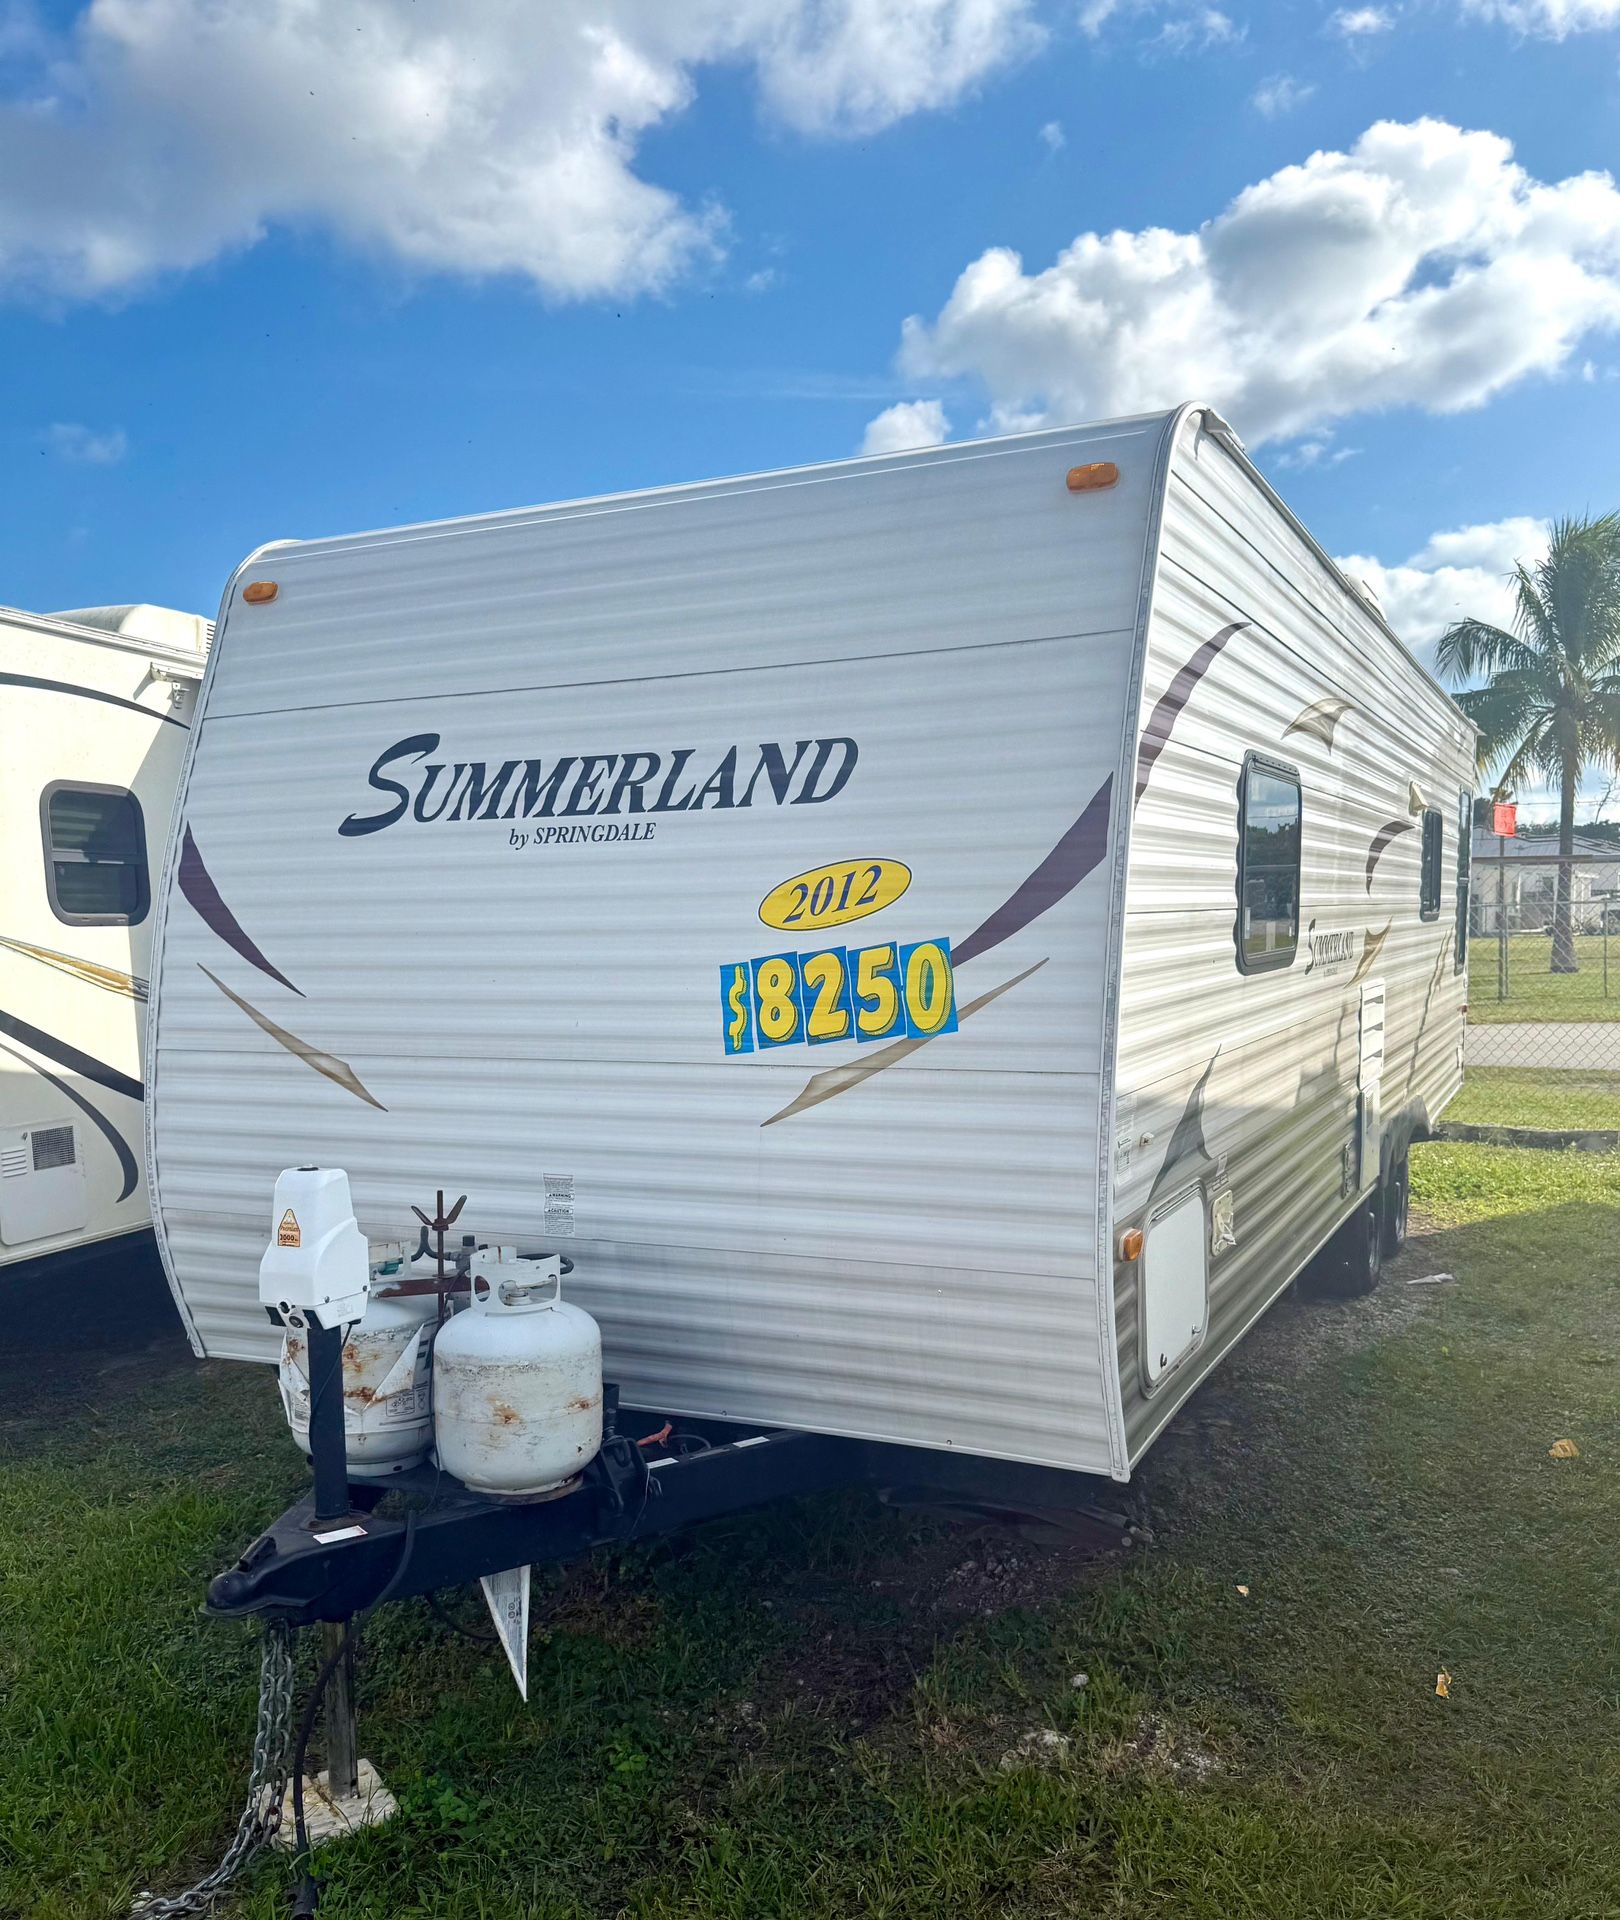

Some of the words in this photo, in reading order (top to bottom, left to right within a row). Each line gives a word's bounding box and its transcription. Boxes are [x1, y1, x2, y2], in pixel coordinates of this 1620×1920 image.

[337, 732, 859, 837] SUMMERLAND
[509, 828, 529, 851] by
[534, 822, 657, 845] SPRINGDALE
[782, 865, 882, 924] 2012
[728, 942, 952, 1051] $8250
